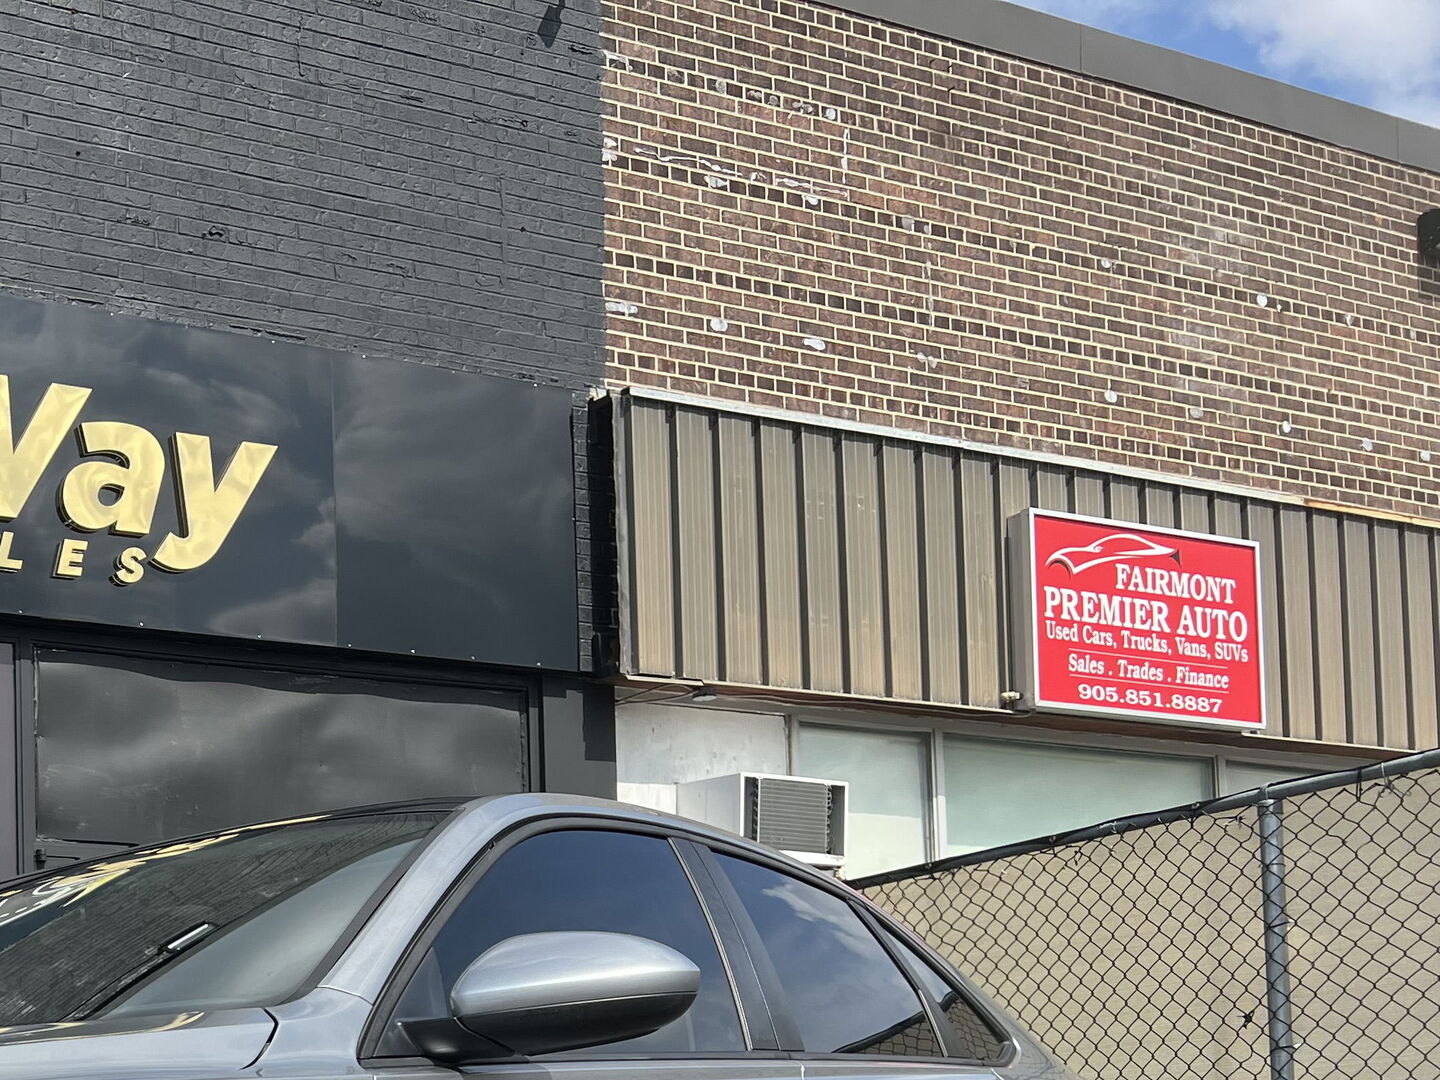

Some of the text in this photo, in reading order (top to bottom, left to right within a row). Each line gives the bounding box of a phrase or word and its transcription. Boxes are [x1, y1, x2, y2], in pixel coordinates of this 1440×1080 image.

[1115, 563, 1236, 604] FAIRMONT
[1043, 585, 1248, 642] PREMIER AUTO
[1045, 620, 1249, 663] Used Cars, Trucks, Vans, SUVs
[1068, 653, 1229, 689] Sales Trades Finance
[1077, 683, 1223, 714] 905.851.8887
